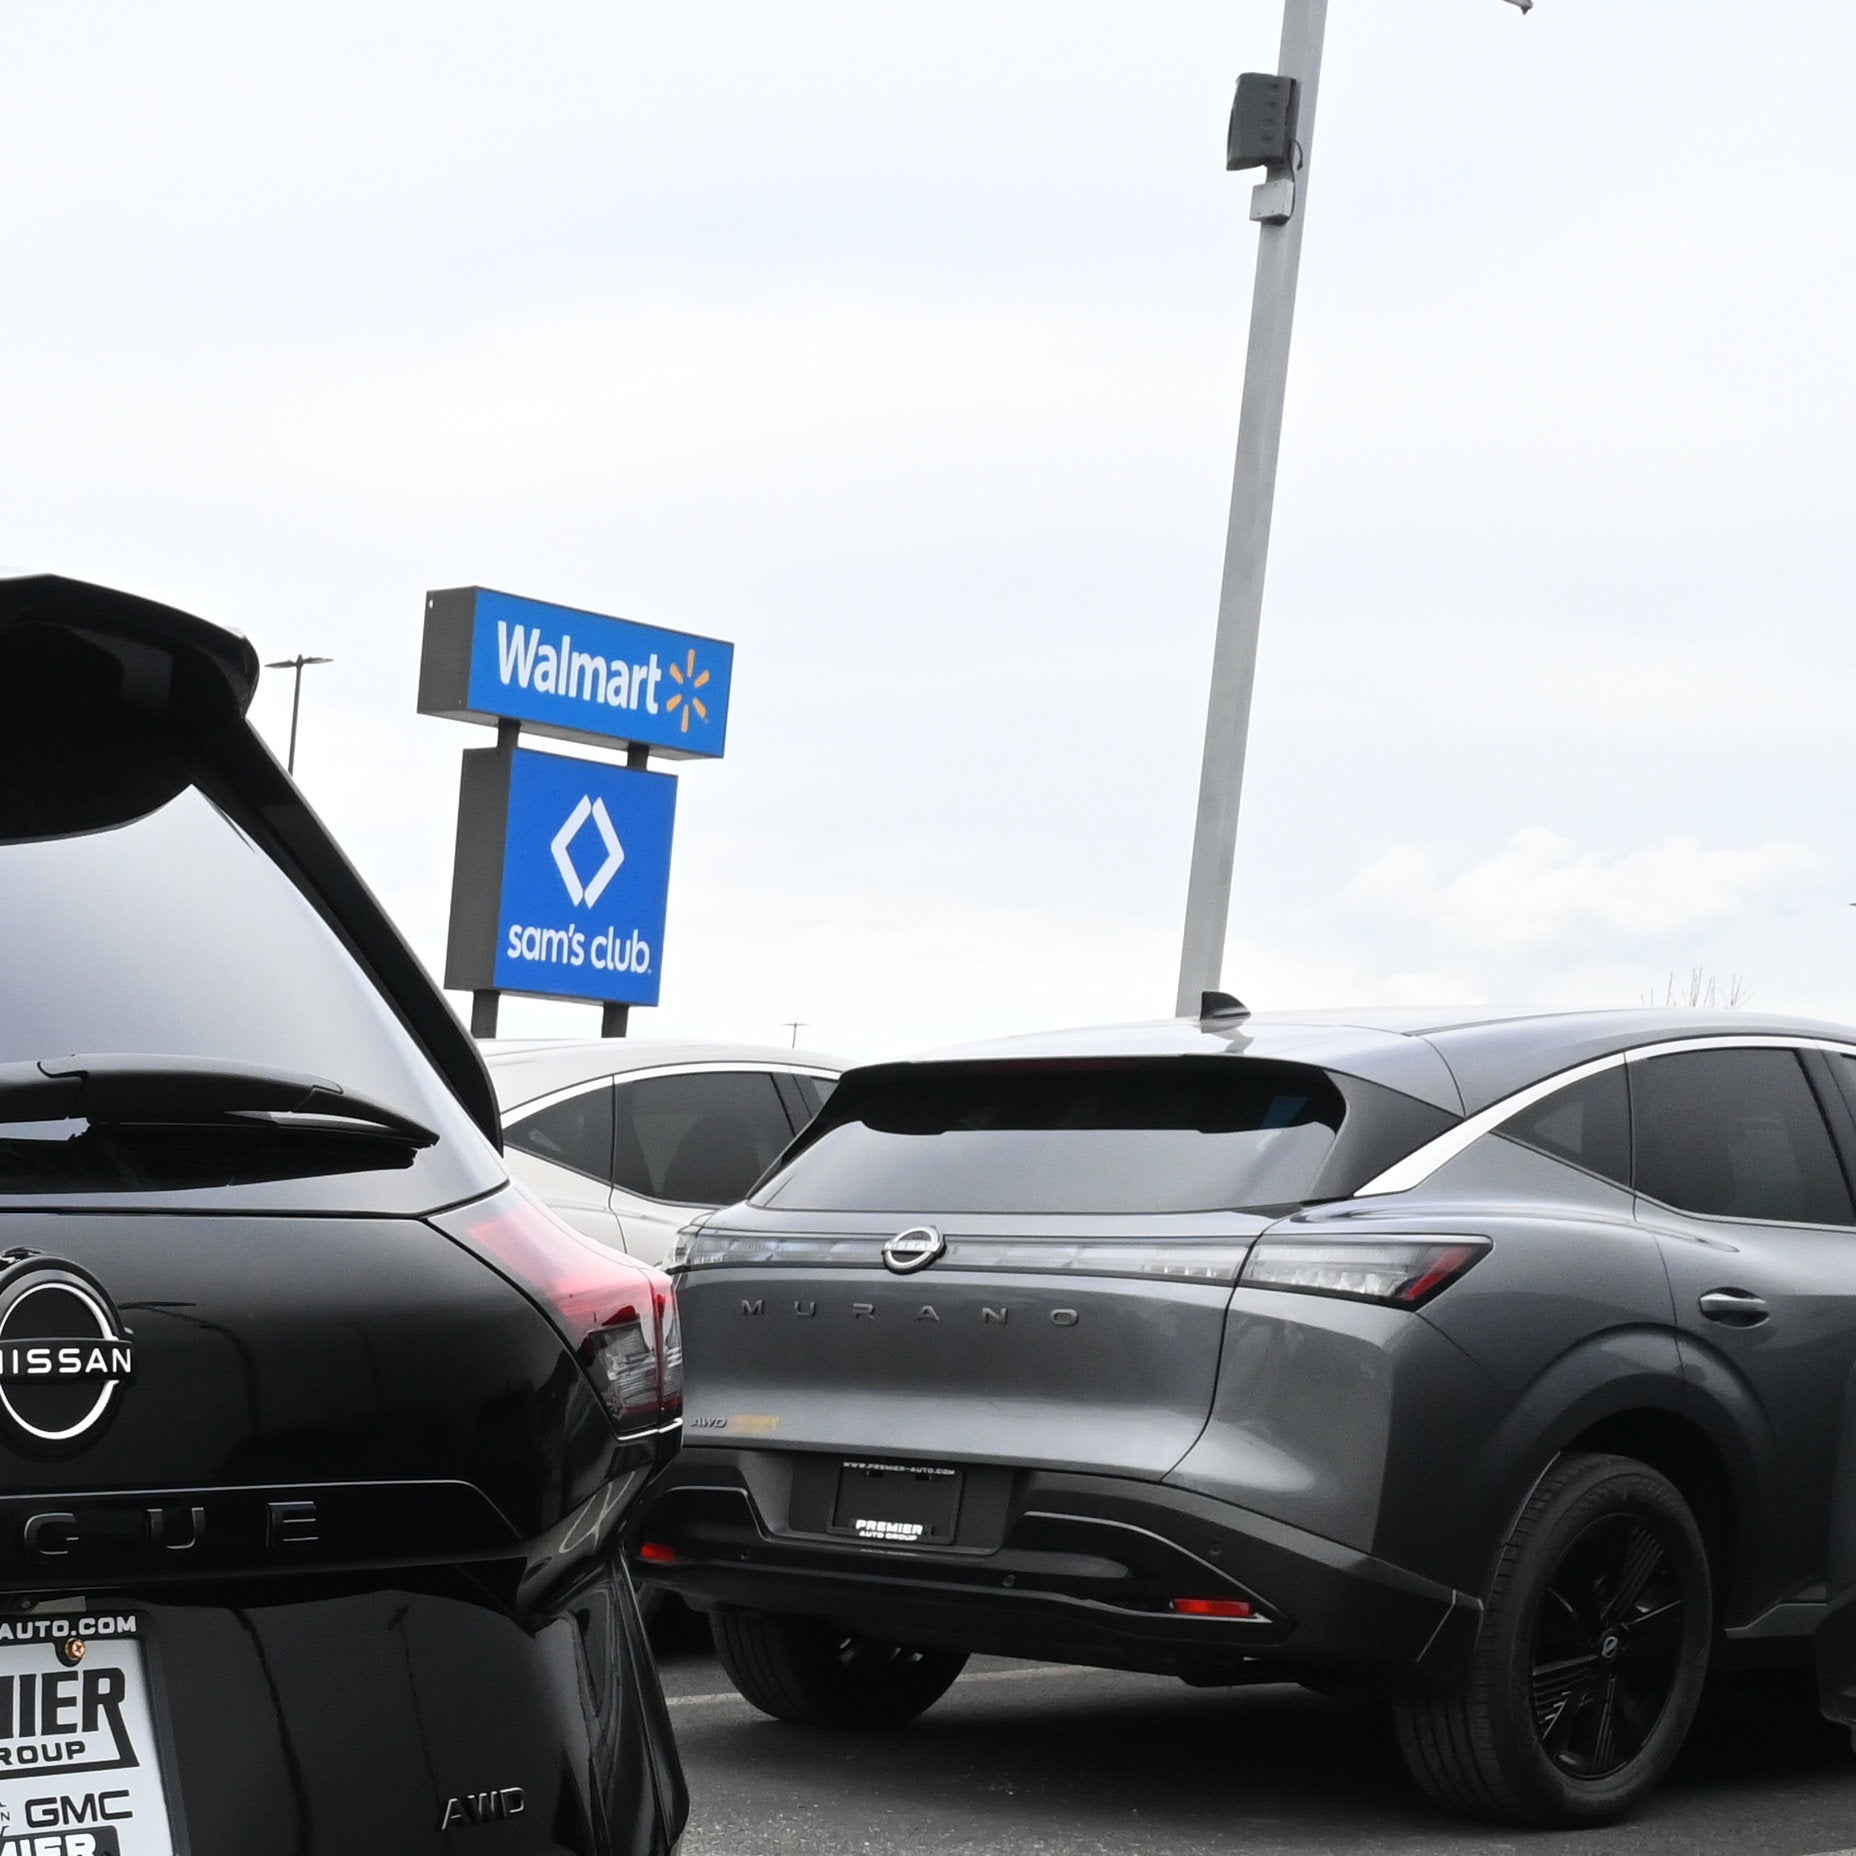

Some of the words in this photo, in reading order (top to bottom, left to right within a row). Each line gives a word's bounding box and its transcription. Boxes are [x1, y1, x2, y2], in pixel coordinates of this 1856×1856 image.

[497, 621, 662, 714] Walmart
[507, 923, 585, 965] sam's
[590, 926, 650, 974] club
[884, 1239, 941, 1252] NISSAN
[741, 1299, 1078, 1327] MURANO
[690, 1416, 727, 1428] AWD
[855, 1519, 923, 1535] PREMIER
[859, 1531, 884, 1539] AUTO
[886, 1533, 918, 1541] GROUP
[25, 1789, 134, 1829] GMC
[440, 1787, 526, 1831] AWD
